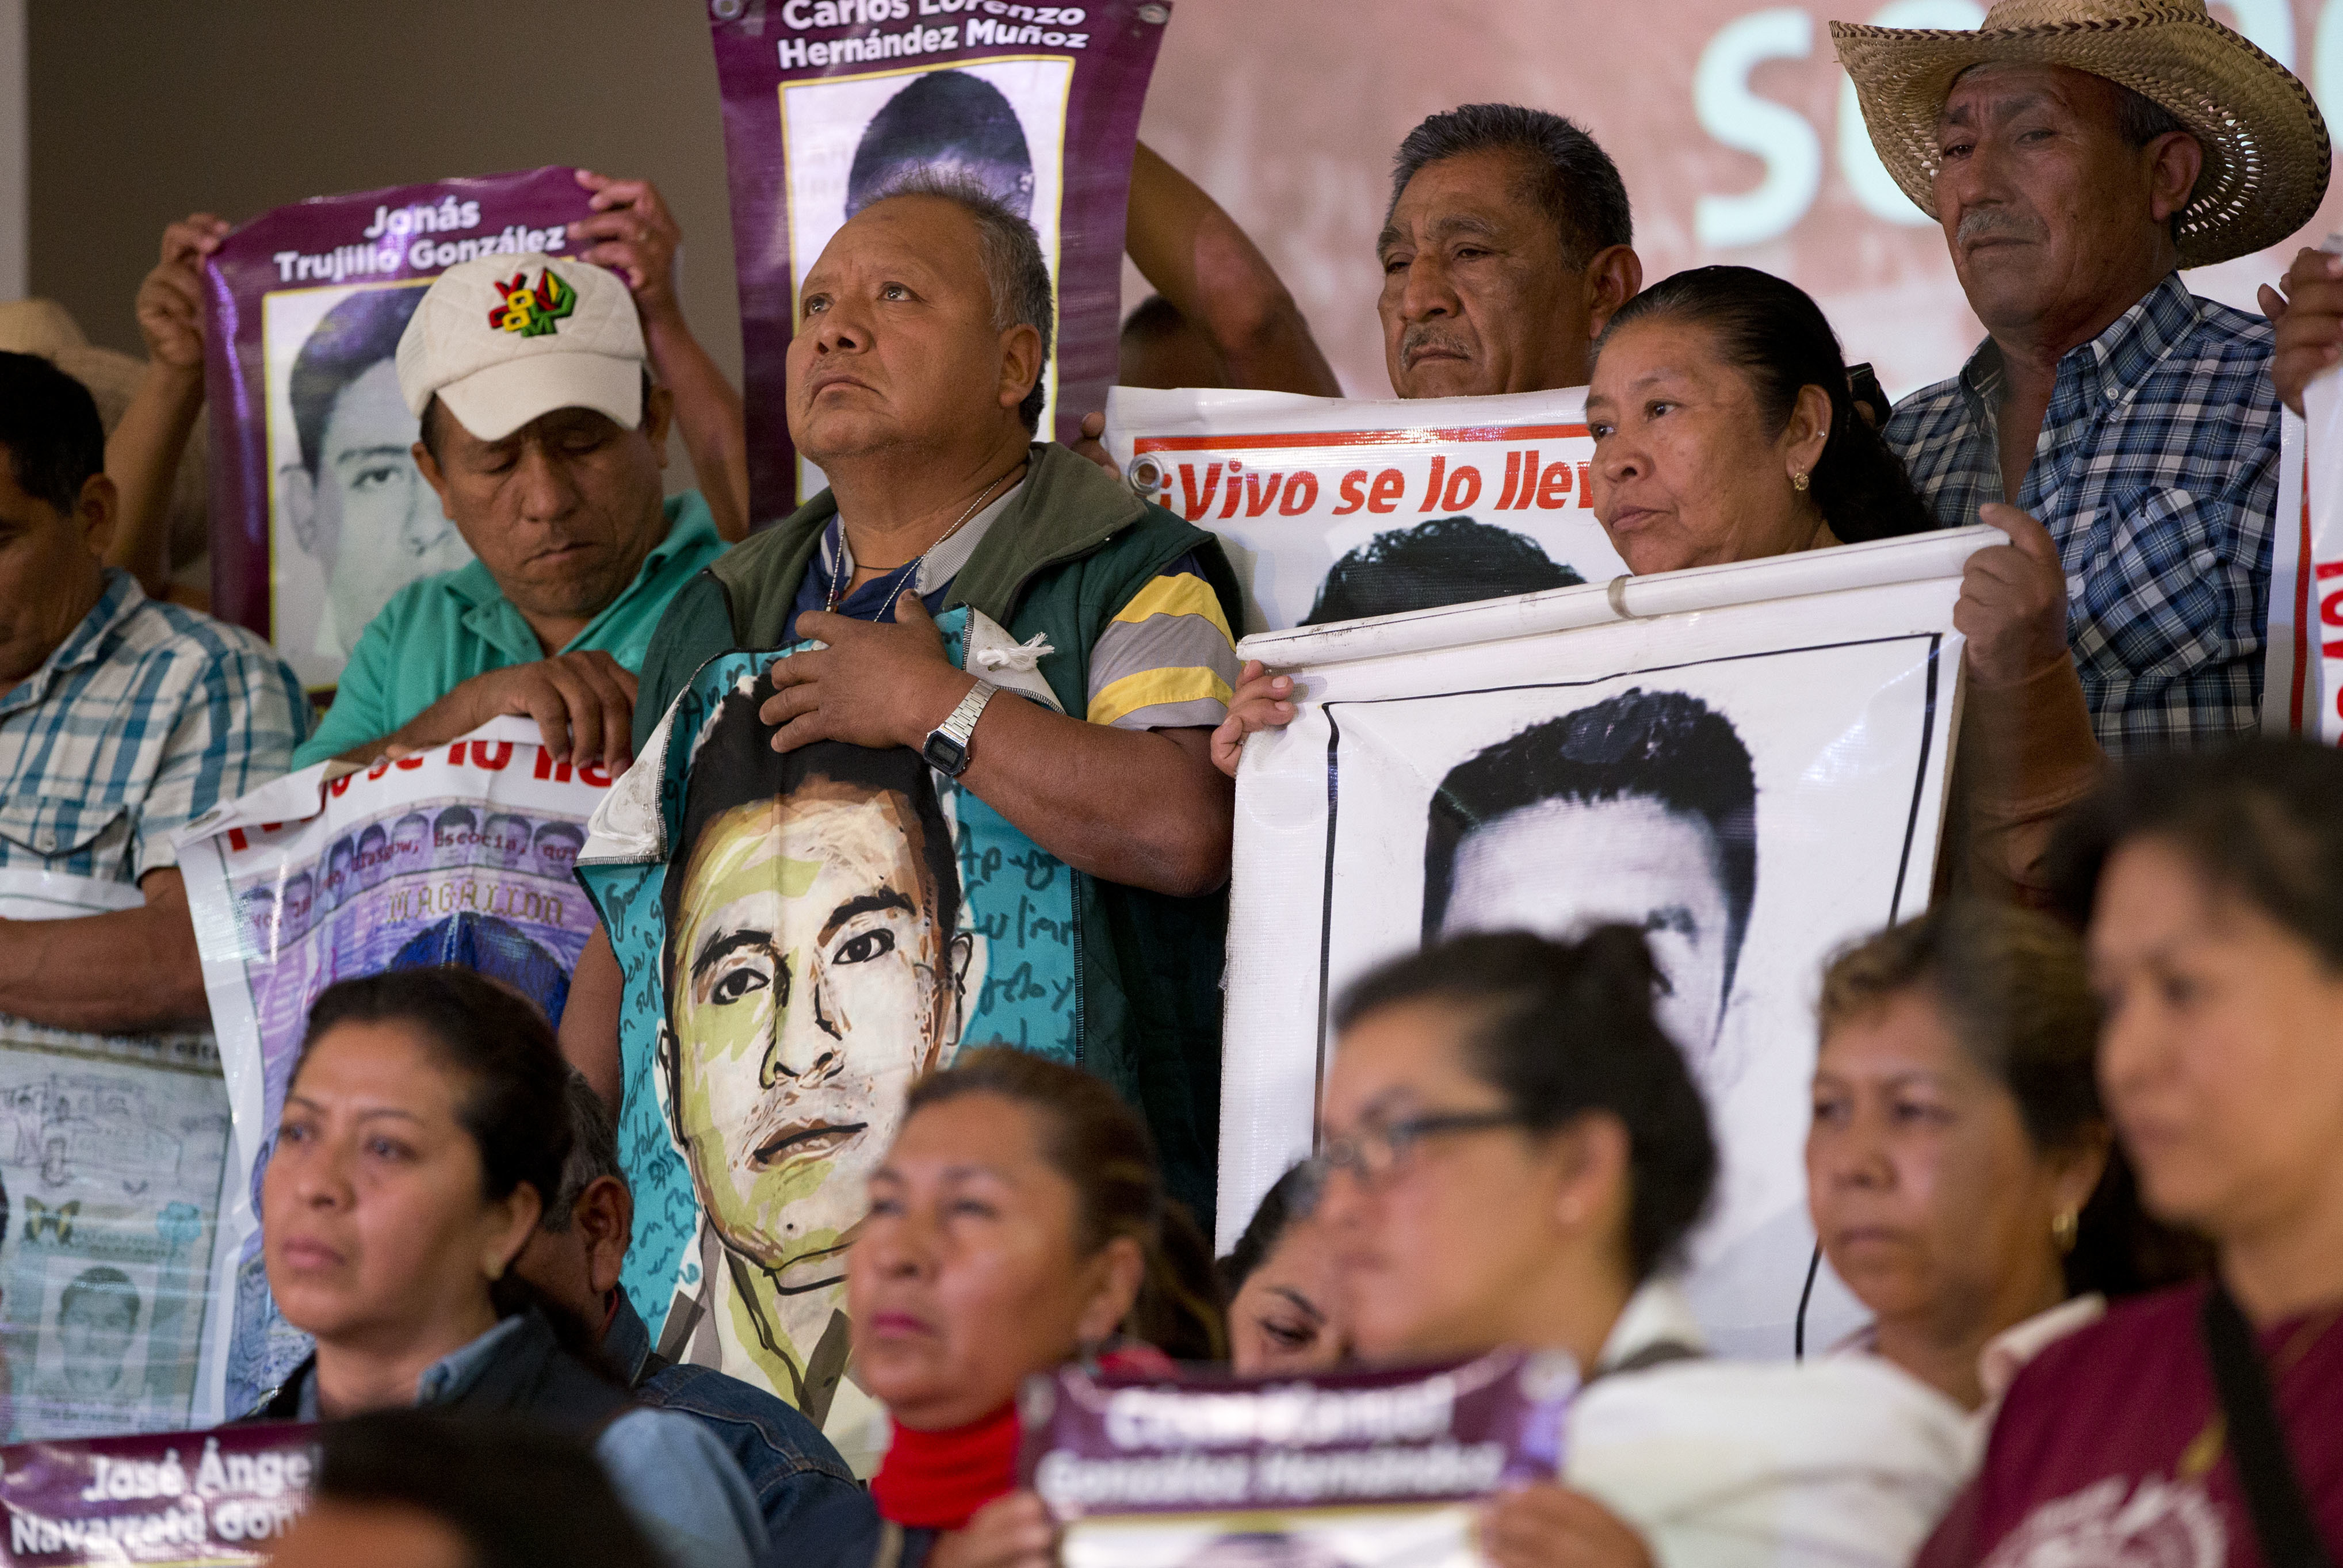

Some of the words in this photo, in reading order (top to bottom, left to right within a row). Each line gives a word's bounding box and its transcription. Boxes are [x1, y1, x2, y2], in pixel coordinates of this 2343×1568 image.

[782, 0, 910, 30] Carlos
[919, 0, 1086, 26] Lorenzo
[777, 24, 960, 70] Hernández
[966, 18, 1090, 48] Muñoz
[364, 196, 481, 238] Jonás
[273, 242, 403, 282] Trujillo
[409, 224, 567, 270] González
[1332, 468, 1405, 515] se
[1418, 456, 1482, 511] lo
[434, 829, 526, 855] Escocia,
[82, 1448, 184, 1501] José
